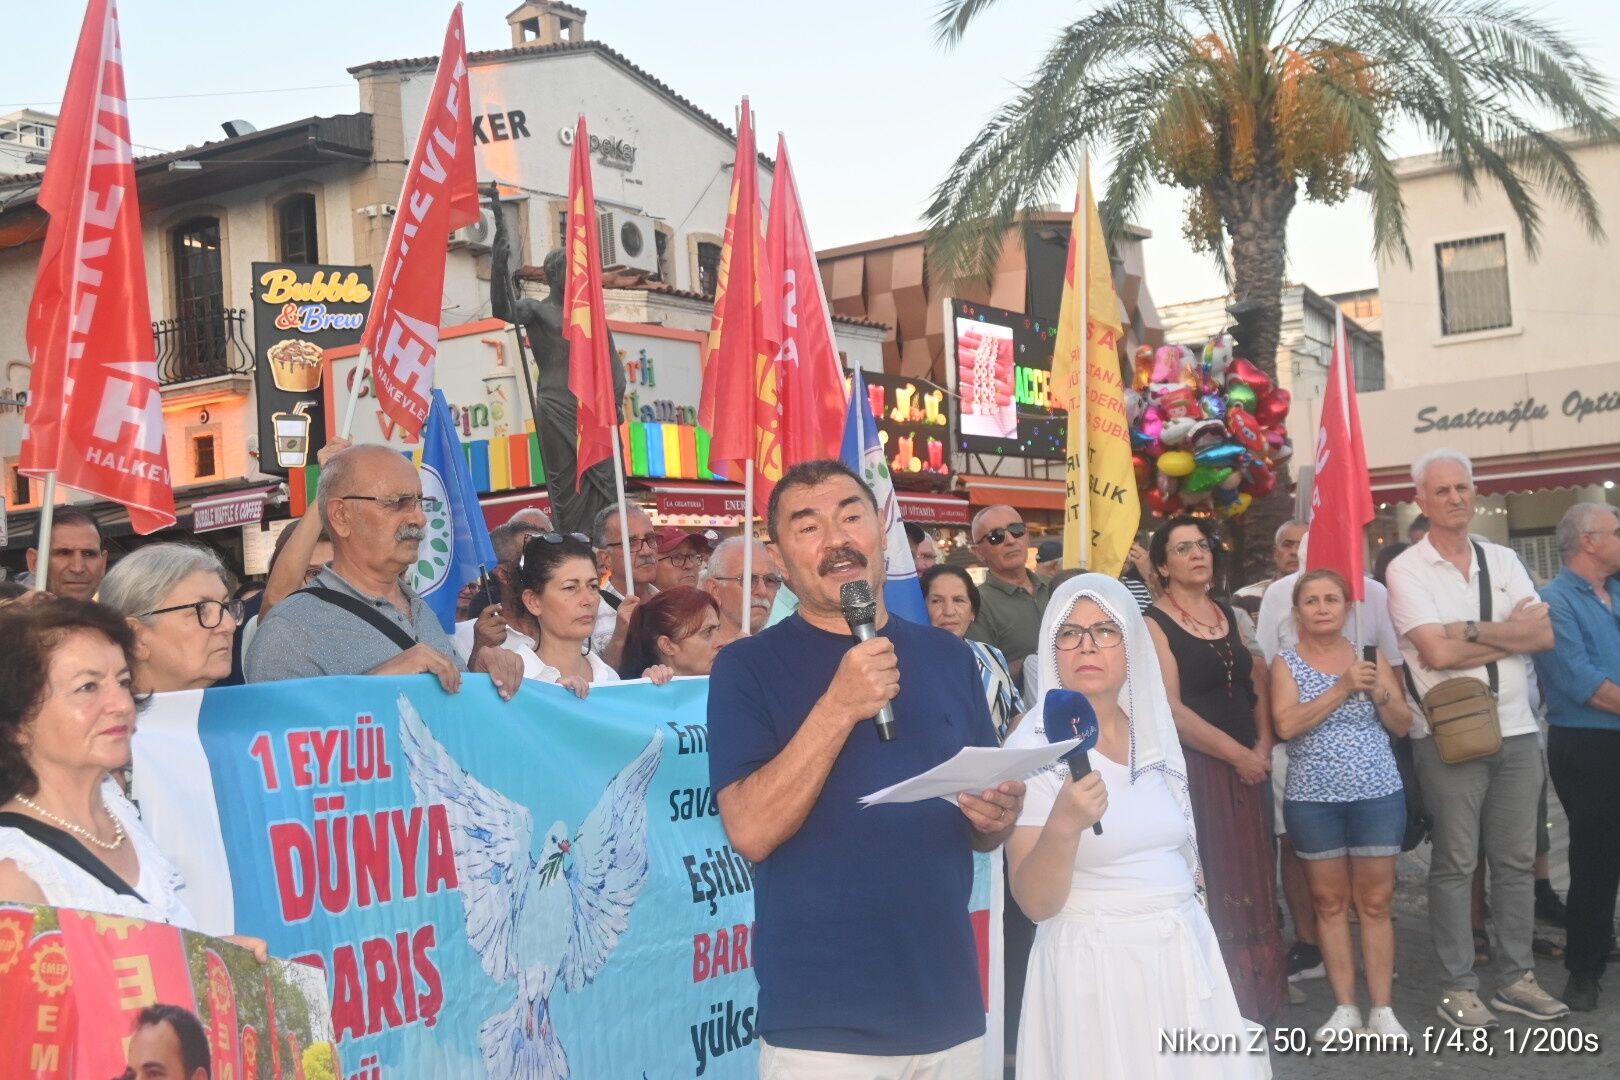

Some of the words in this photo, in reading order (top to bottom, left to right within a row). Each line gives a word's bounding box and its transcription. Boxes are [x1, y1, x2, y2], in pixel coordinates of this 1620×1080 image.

[260, 268, 371, 304] Bubble
[298, 303, 363, 333] Brew
[377, 365, 430, 423] HALKEVLE
[1015, 366, 1058, 409] ACCE
[1414, 398, 1548, 433] Saatçıoğlu
[1562, 390, 1620, 423] Opti
[240, 500, 262, 519] COFFEE
[250, 734, 278, 790] 1
[287, 715, 392, 787] EYLÜL
[269, 795, 459, 923] DÜNYA
